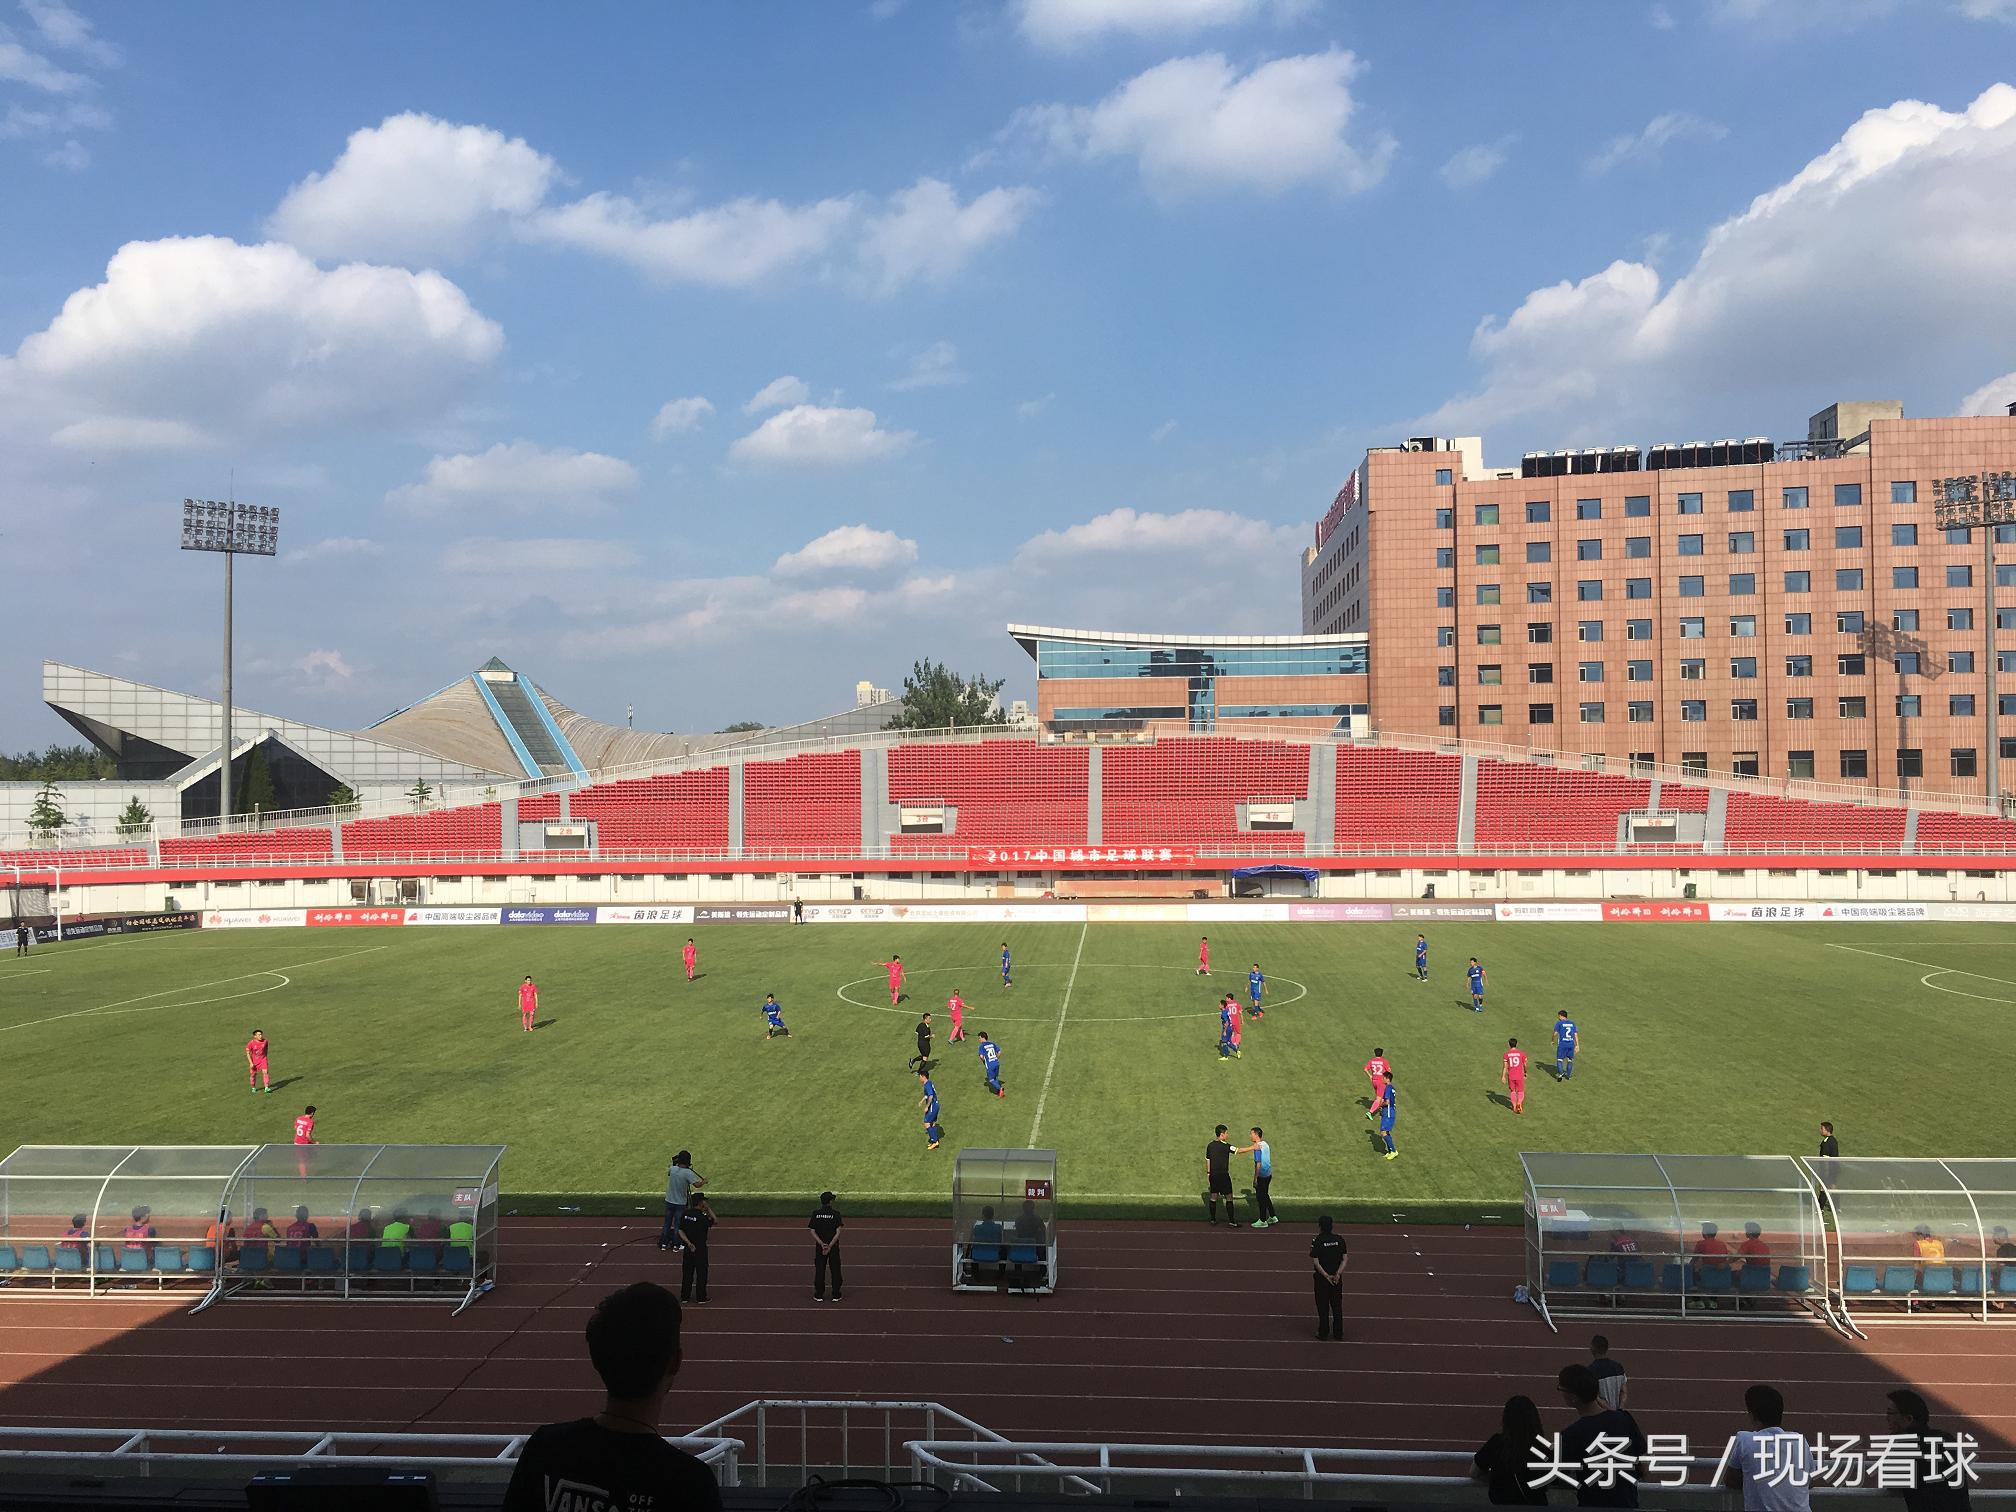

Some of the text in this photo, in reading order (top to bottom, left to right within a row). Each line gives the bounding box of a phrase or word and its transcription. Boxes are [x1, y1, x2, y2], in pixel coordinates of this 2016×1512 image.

[633, 910, 683, 920] 茵浪足球
[1751, 906, 1805, 918] 茵浪足球
[1565, 1027, 1571, 1038] 2
[1509, 1056, 1520, 1068] 19
[1371, 1064, 1383, 1076] 32
[296, 1124, 304, 1137] 6
[629, 1494, 655, 1506] OFF
